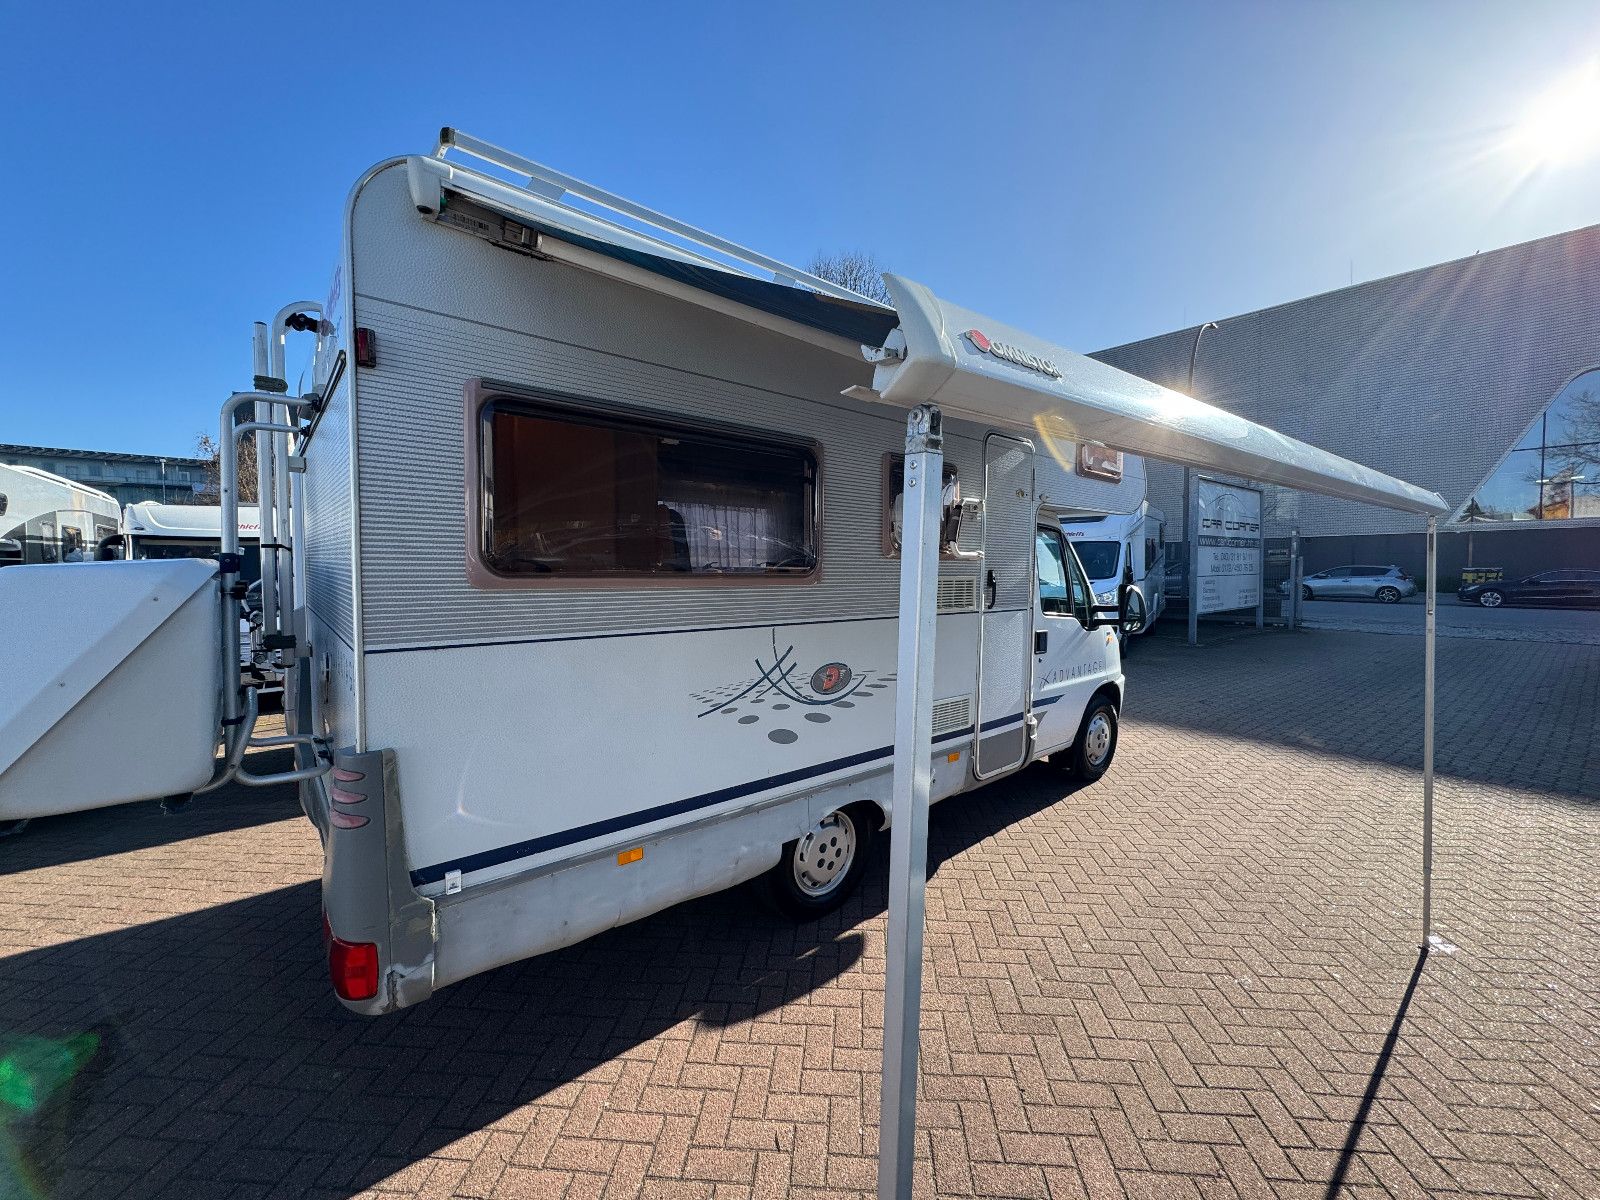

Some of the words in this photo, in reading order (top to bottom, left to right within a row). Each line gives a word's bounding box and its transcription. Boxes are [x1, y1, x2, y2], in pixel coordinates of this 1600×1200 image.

[989, 342, 1062, 378] OMNISTOR
[1202, 518, 1223, 530] CAR
[1225, 520, 1259, 533] CORNER
[1053, 660, 1103, 684] ADVANTAGE
